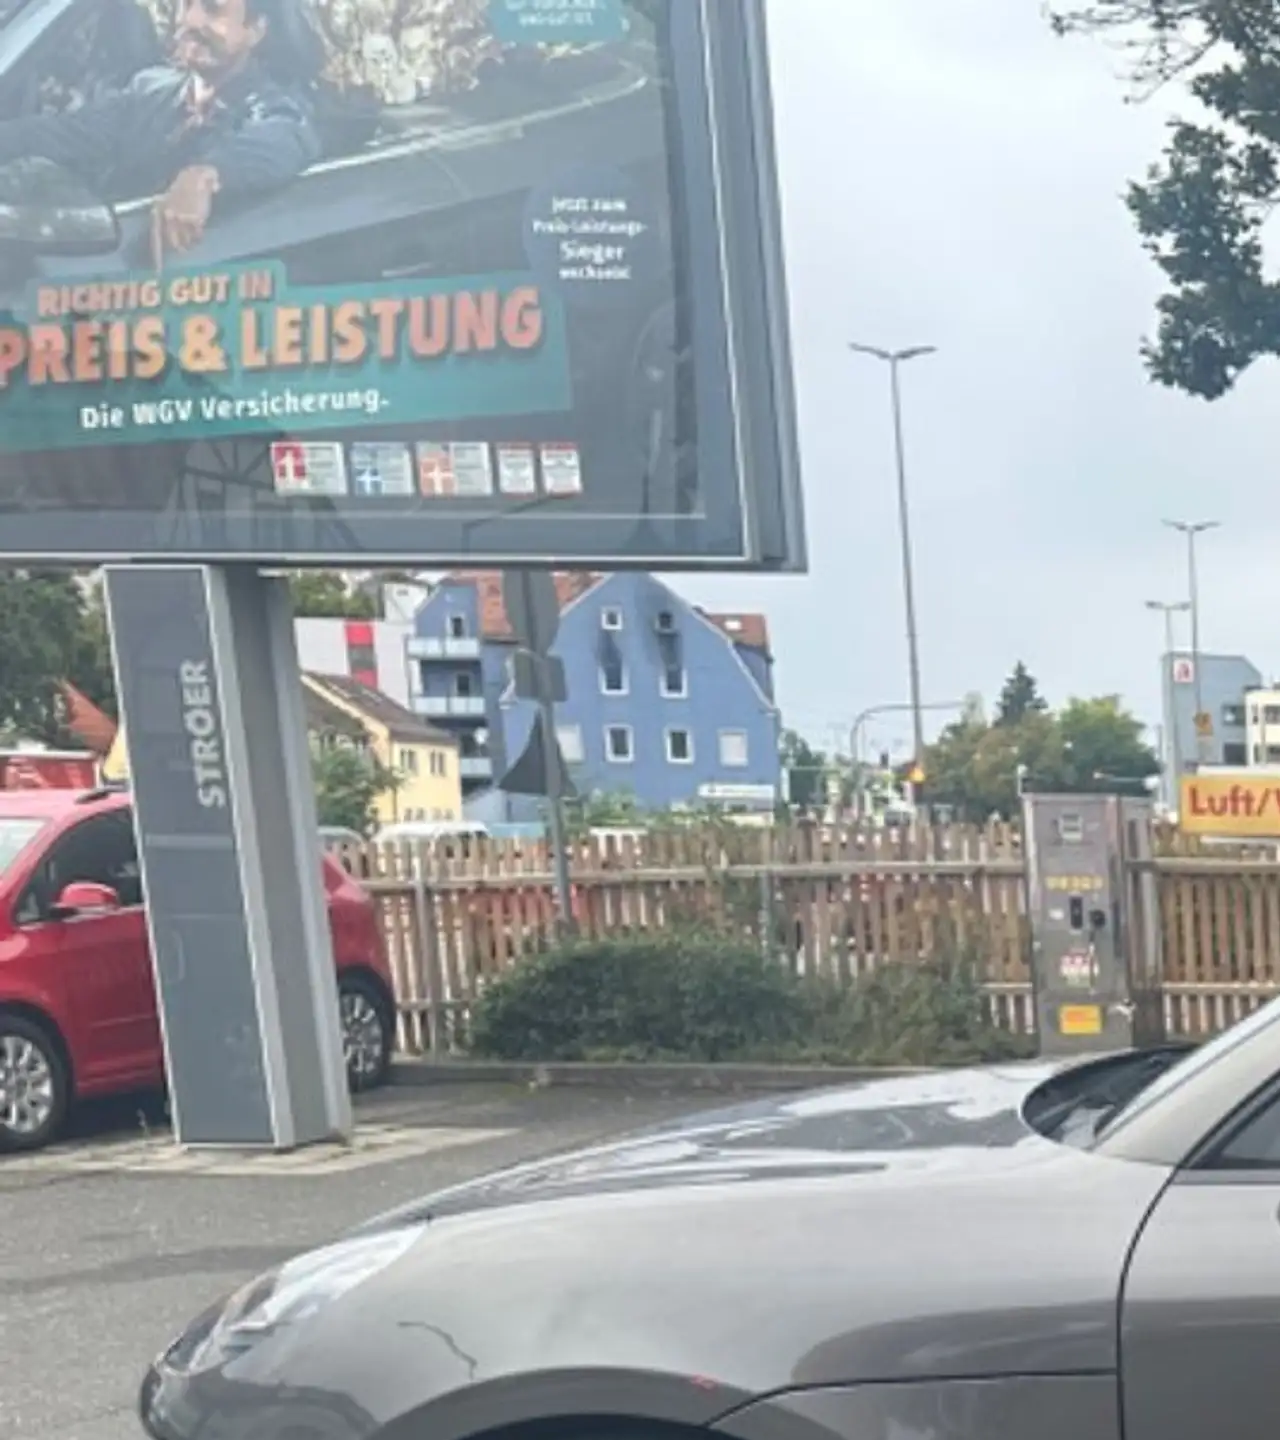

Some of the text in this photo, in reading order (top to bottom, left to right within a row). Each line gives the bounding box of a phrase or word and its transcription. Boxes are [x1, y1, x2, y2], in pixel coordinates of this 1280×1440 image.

[560, 240, 625, 265] Sieger
[37, 269, 272, 316] RICHTIG GUT IN
[0, 286, 543, 388] PREIS & LEISTUNG
[80, 387, 390, 428] Die WGV Versicherung.
